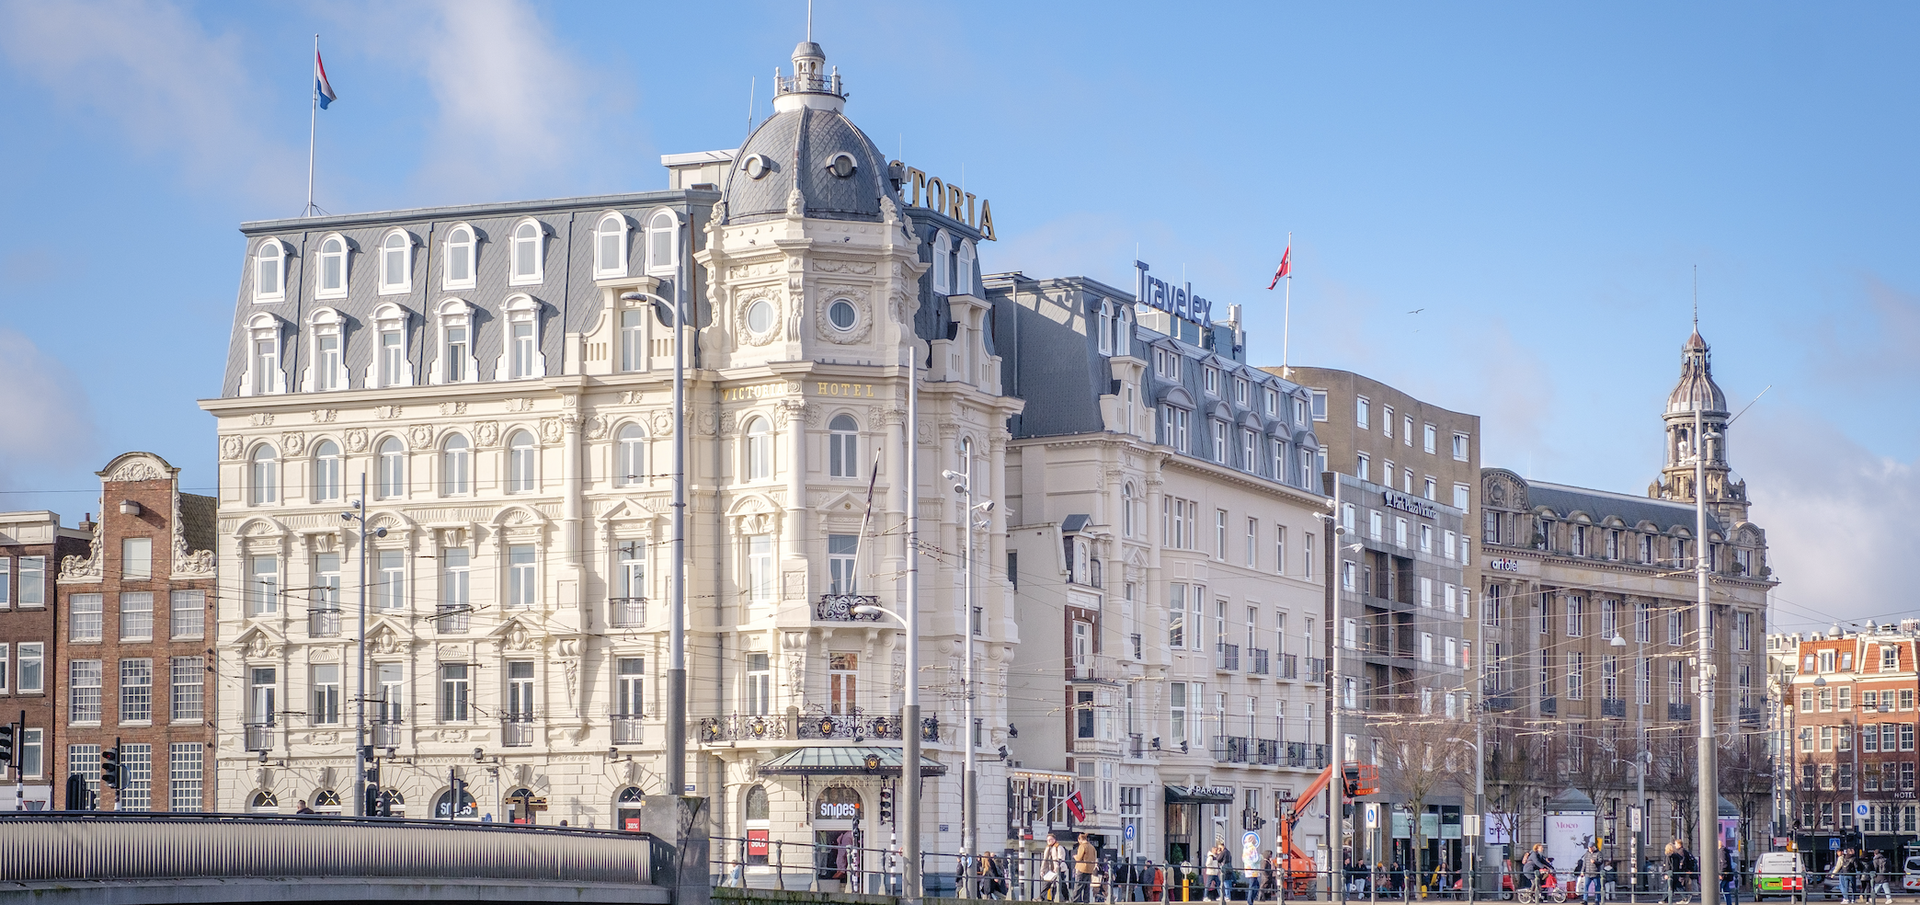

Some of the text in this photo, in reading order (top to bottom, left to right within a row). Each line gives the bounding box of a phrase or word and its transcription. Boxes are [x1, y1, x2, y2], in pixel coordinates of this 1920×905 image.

[1133, 260, 1212, 329] Travelex
[722, 382, 874, 401] VICTORIA HOTEL
[1894, 791, 1917, 799] HOTEL
[820, 803, 855, 818] snipes
